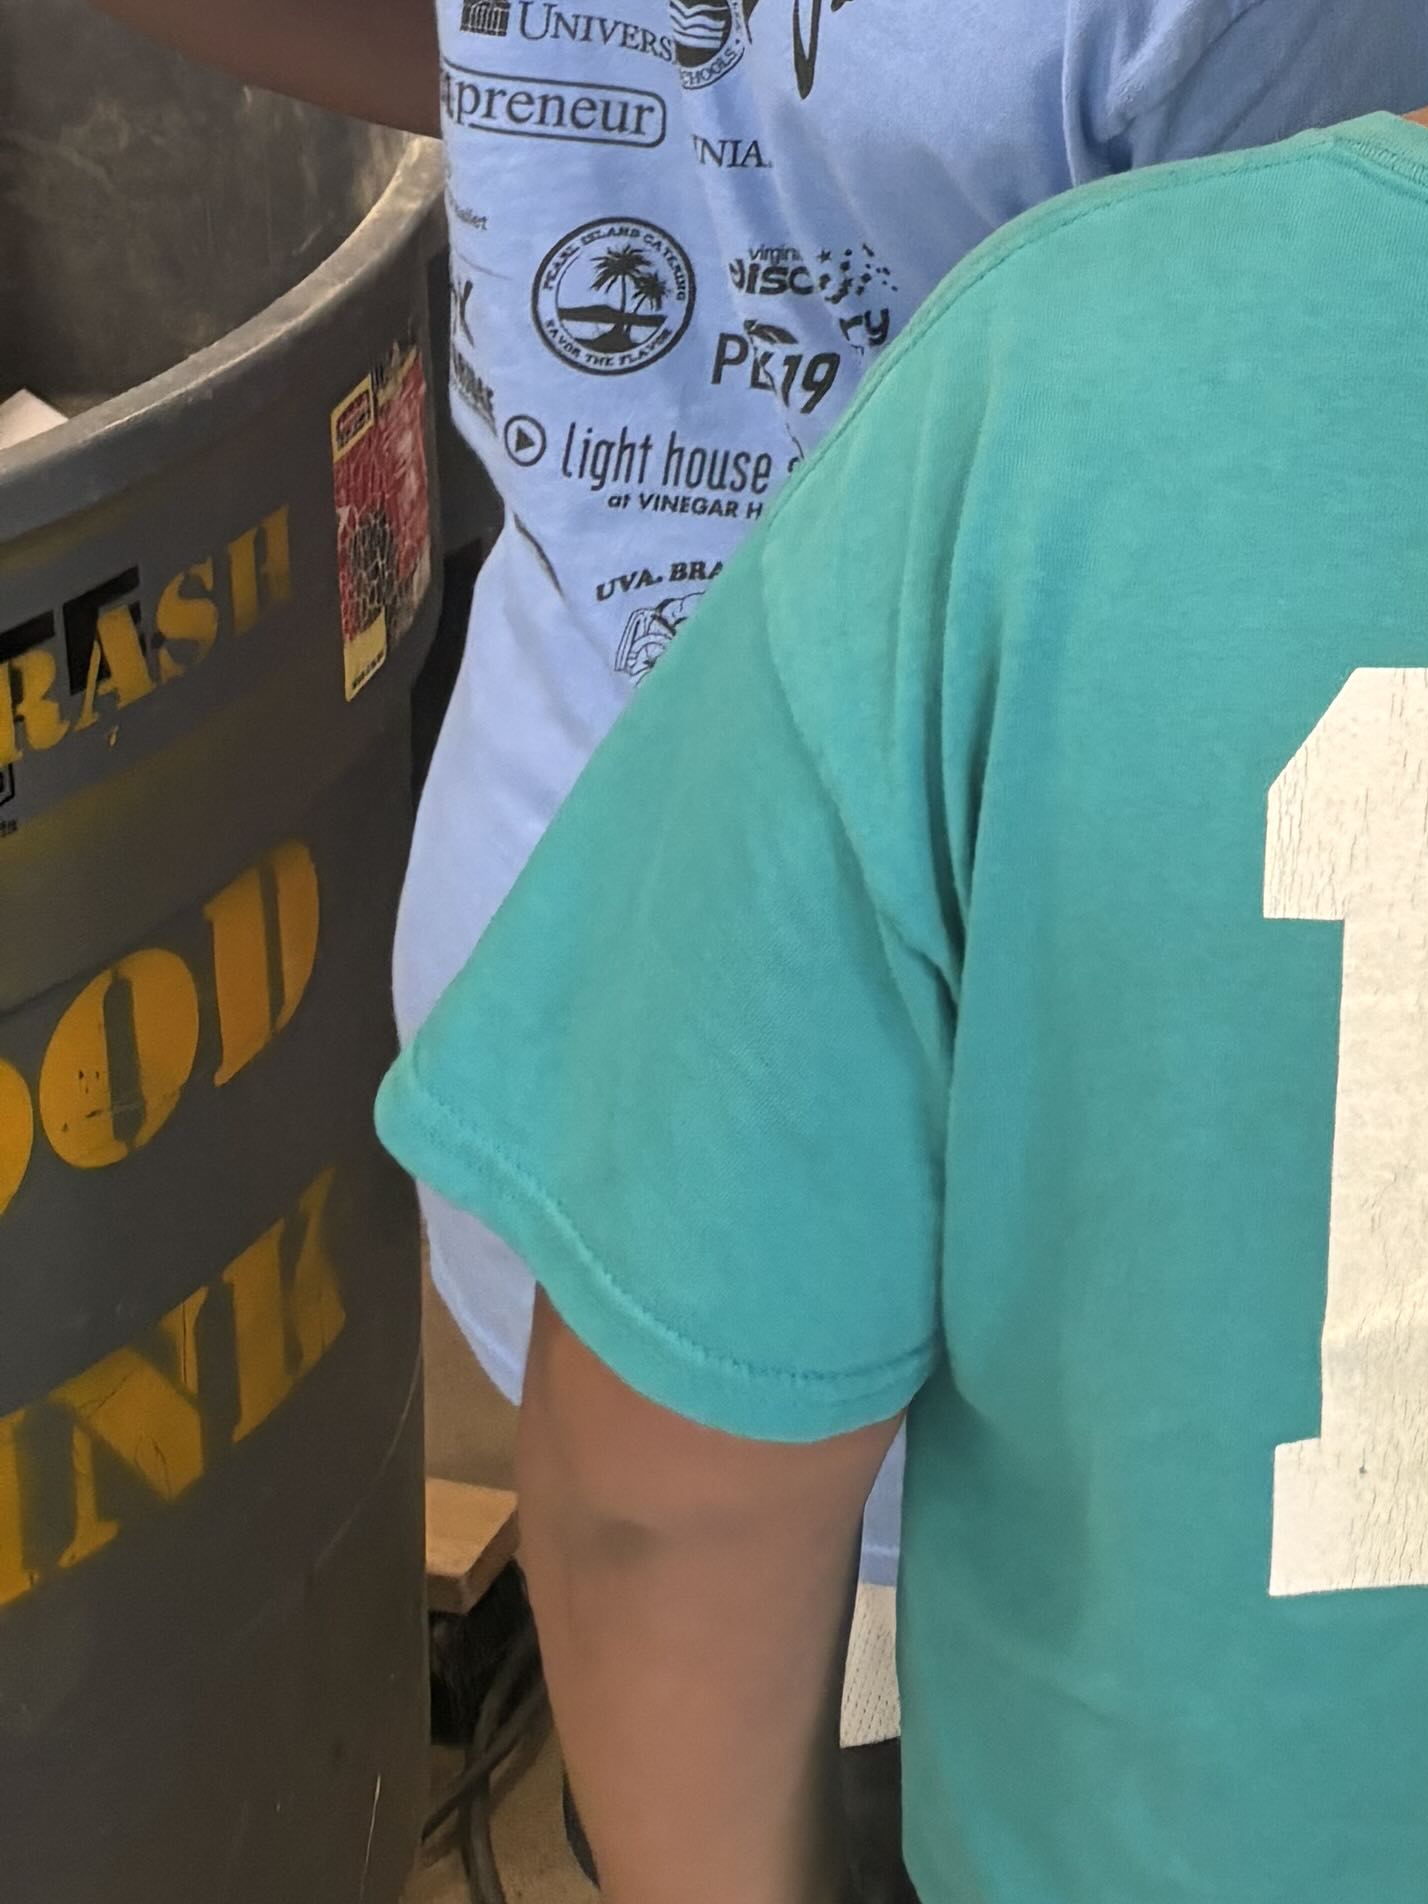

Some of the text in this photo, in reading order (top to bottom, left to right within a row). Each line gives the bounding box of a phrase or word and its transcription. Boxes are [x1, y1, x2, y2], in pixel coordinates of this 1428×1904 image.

[446, 72, 656, 137] preneur
[642, 232, 687, 302] CATERING
[585, 354, 615, 368] THE
[561, 421, 773, 495] light house
[607, 493, 631, 510] at
[637, 492, 739, 519] VINEGAR
[0, 839, 321, 1214] OD
